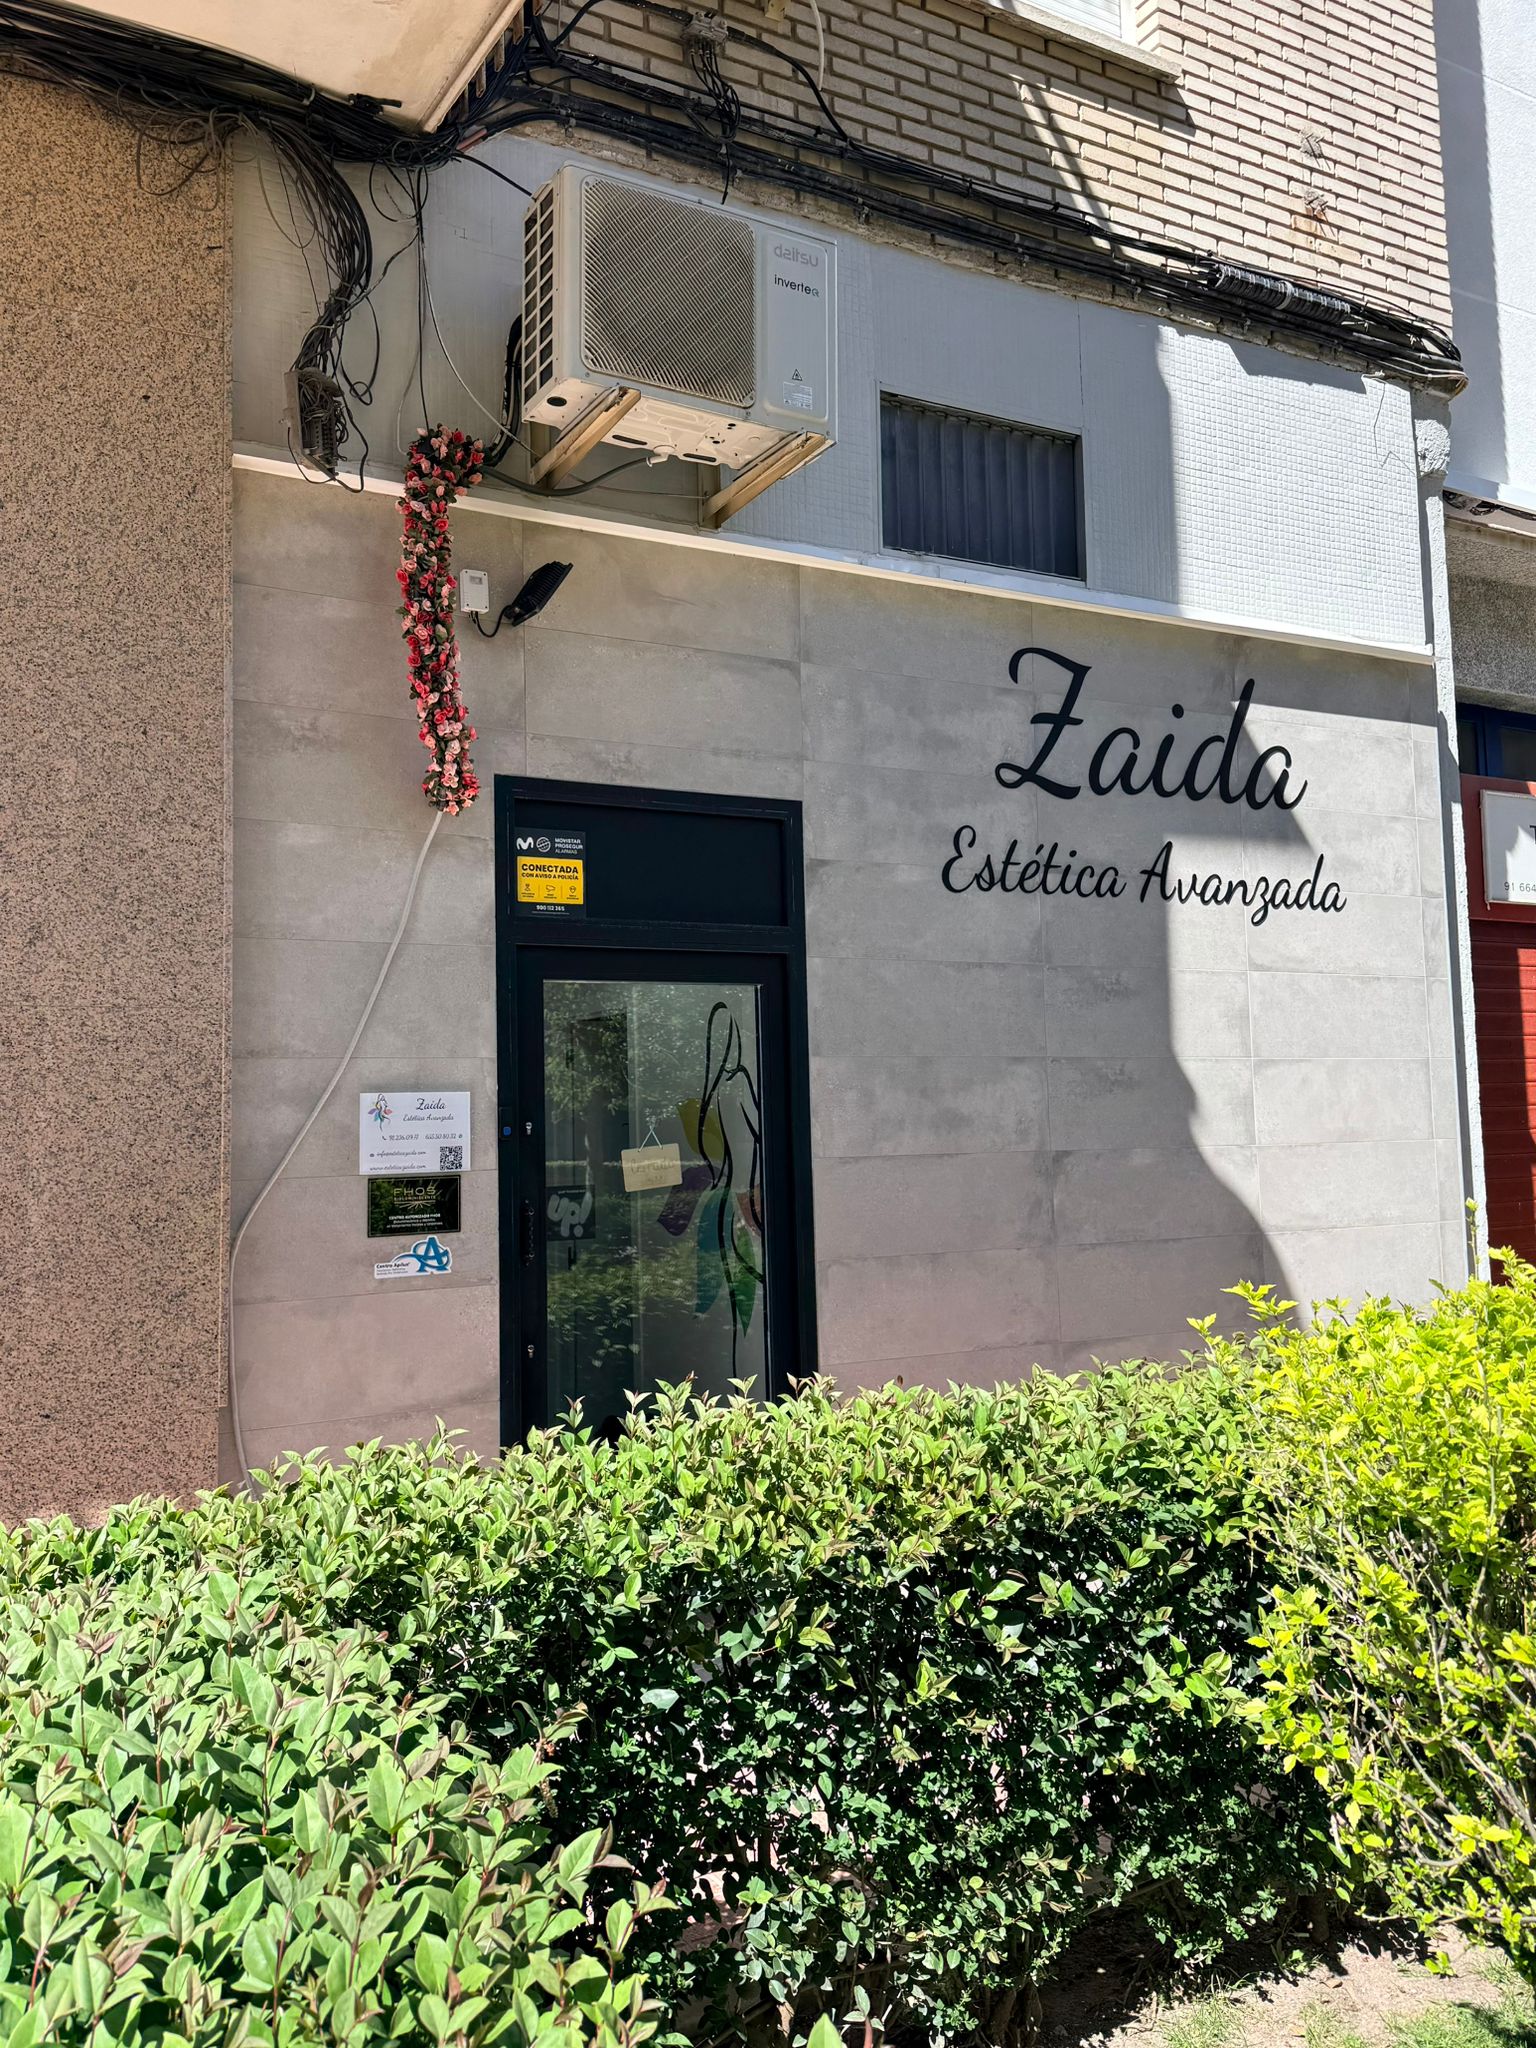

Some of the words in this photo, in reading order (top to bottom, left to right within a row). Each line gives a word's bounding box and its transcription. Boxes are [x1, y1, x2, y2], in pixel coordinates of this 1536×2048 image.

[774, 244, 819, 268] daitsu
[994, 647, 1308, 810] Zaida
[521, 863, 579, 874] CONECTADA
[941, 825, 1127, 898] Estética
[1139, 841, 1347, 927] Avanzada
[1504, 881, 1515, 891] 91
[415, 1097, 446, 1110] Zaida
[393, 1186, 436, 1196] FHOS
